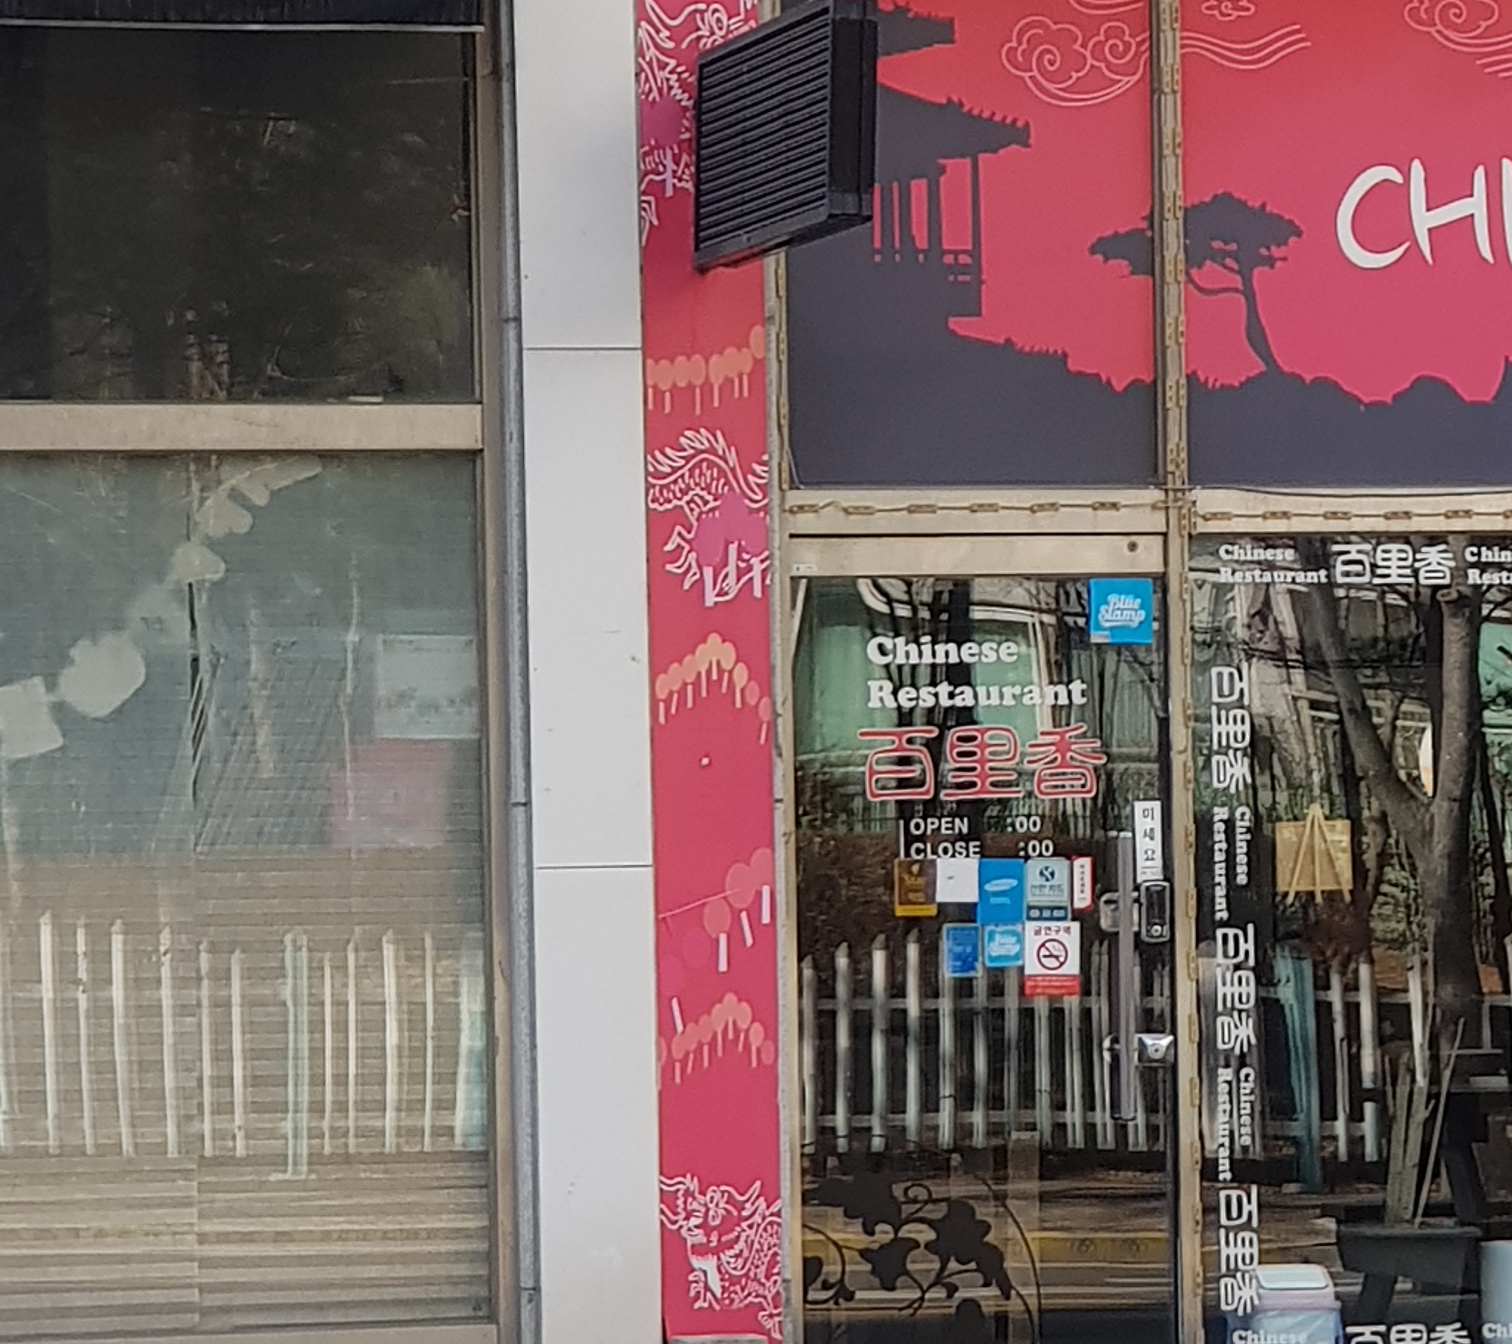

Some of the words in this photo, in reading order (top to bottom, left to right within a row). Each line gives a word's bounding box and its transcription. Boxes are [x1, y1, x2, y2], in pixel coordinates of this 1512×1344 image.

[1218, 567, 1328, 584] Restaurant
[1219, 545, 1296, 562] Chinese
[1331, 543, 1457, 586] 百里香
[866, 635, 1019, 665] Chinese
[867, 678, 1088, 709] Restaurant
[1209, 661, 1252, 794] 百里香
[858, 724, 1107, 801] 百里香
[909, 817, 969, 835] OPEN
[1006, 815, 1042, 834] :00
[909, 841, 981, 859] CLOSE
[1018, 841, 1054, 857] :00
[1235, 805, 1250, 886] Chinese
[1213, 806, 1230, 922] Restaurant
[1215, 923, 1257, 1055] 百里香
[1217, 1067, 1233, 1182] Restaurant
[1239, 1066, 1253, 1147] Chinese
[1219, 1183, 1260, 1316] 百里香
